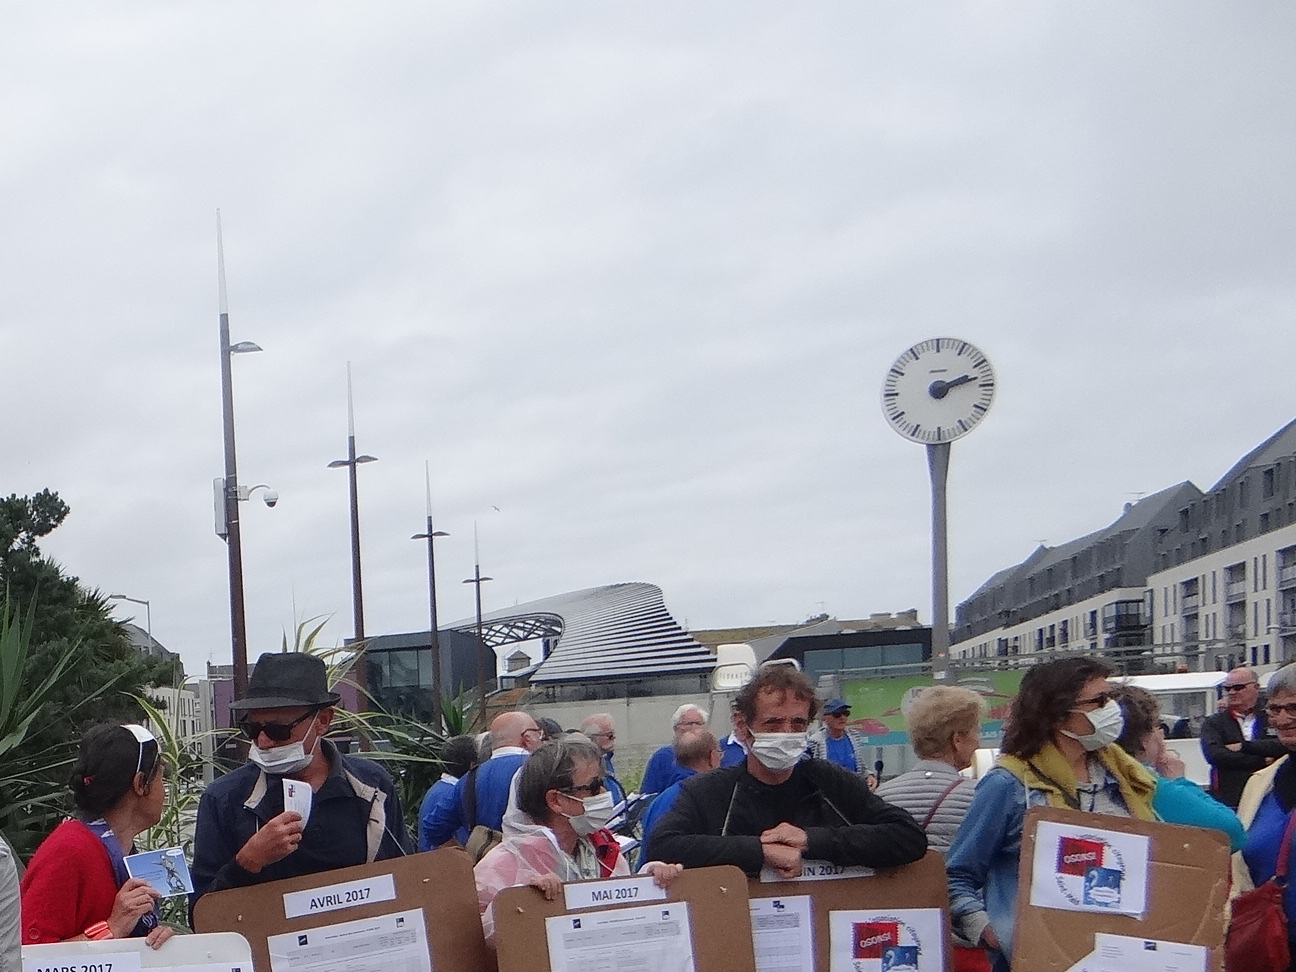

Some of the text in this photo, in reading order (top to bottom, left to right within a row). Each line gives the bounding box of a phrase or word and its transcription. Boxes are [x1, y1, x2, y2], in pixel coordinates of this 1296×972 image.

[309, 887, 371, 910] AVRIL 2017
[591, 887, 639, 901] MAI 2017
